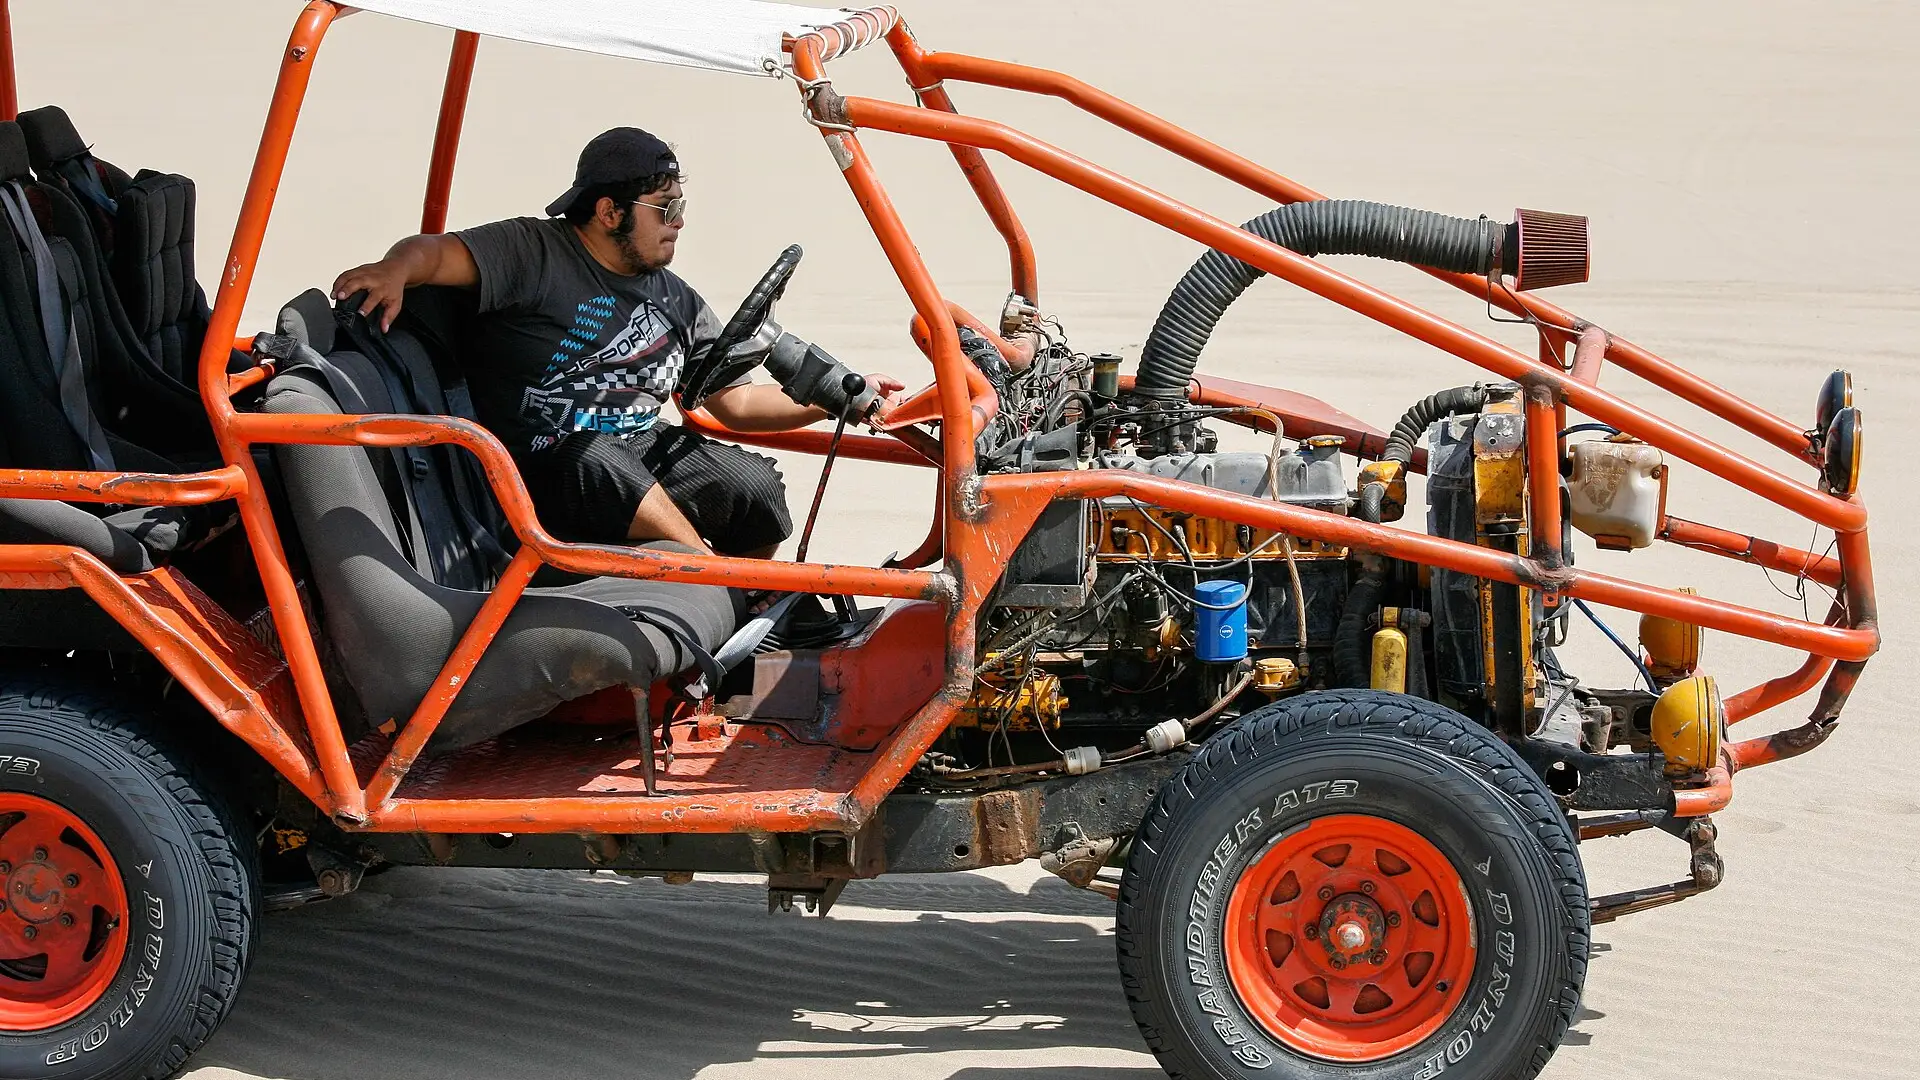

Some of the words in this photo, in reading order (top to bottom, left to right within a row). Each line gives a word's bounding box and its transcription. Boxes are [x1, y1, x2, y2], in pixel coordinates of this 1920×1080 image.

[45, 890, 165, 1066] DUNLOP
[1187, 807, 1272, 1069] GRANDTREK
[1271, 779, 1359, 819] AT3
[1412, 888, 1515, 1080] DUNLOP
